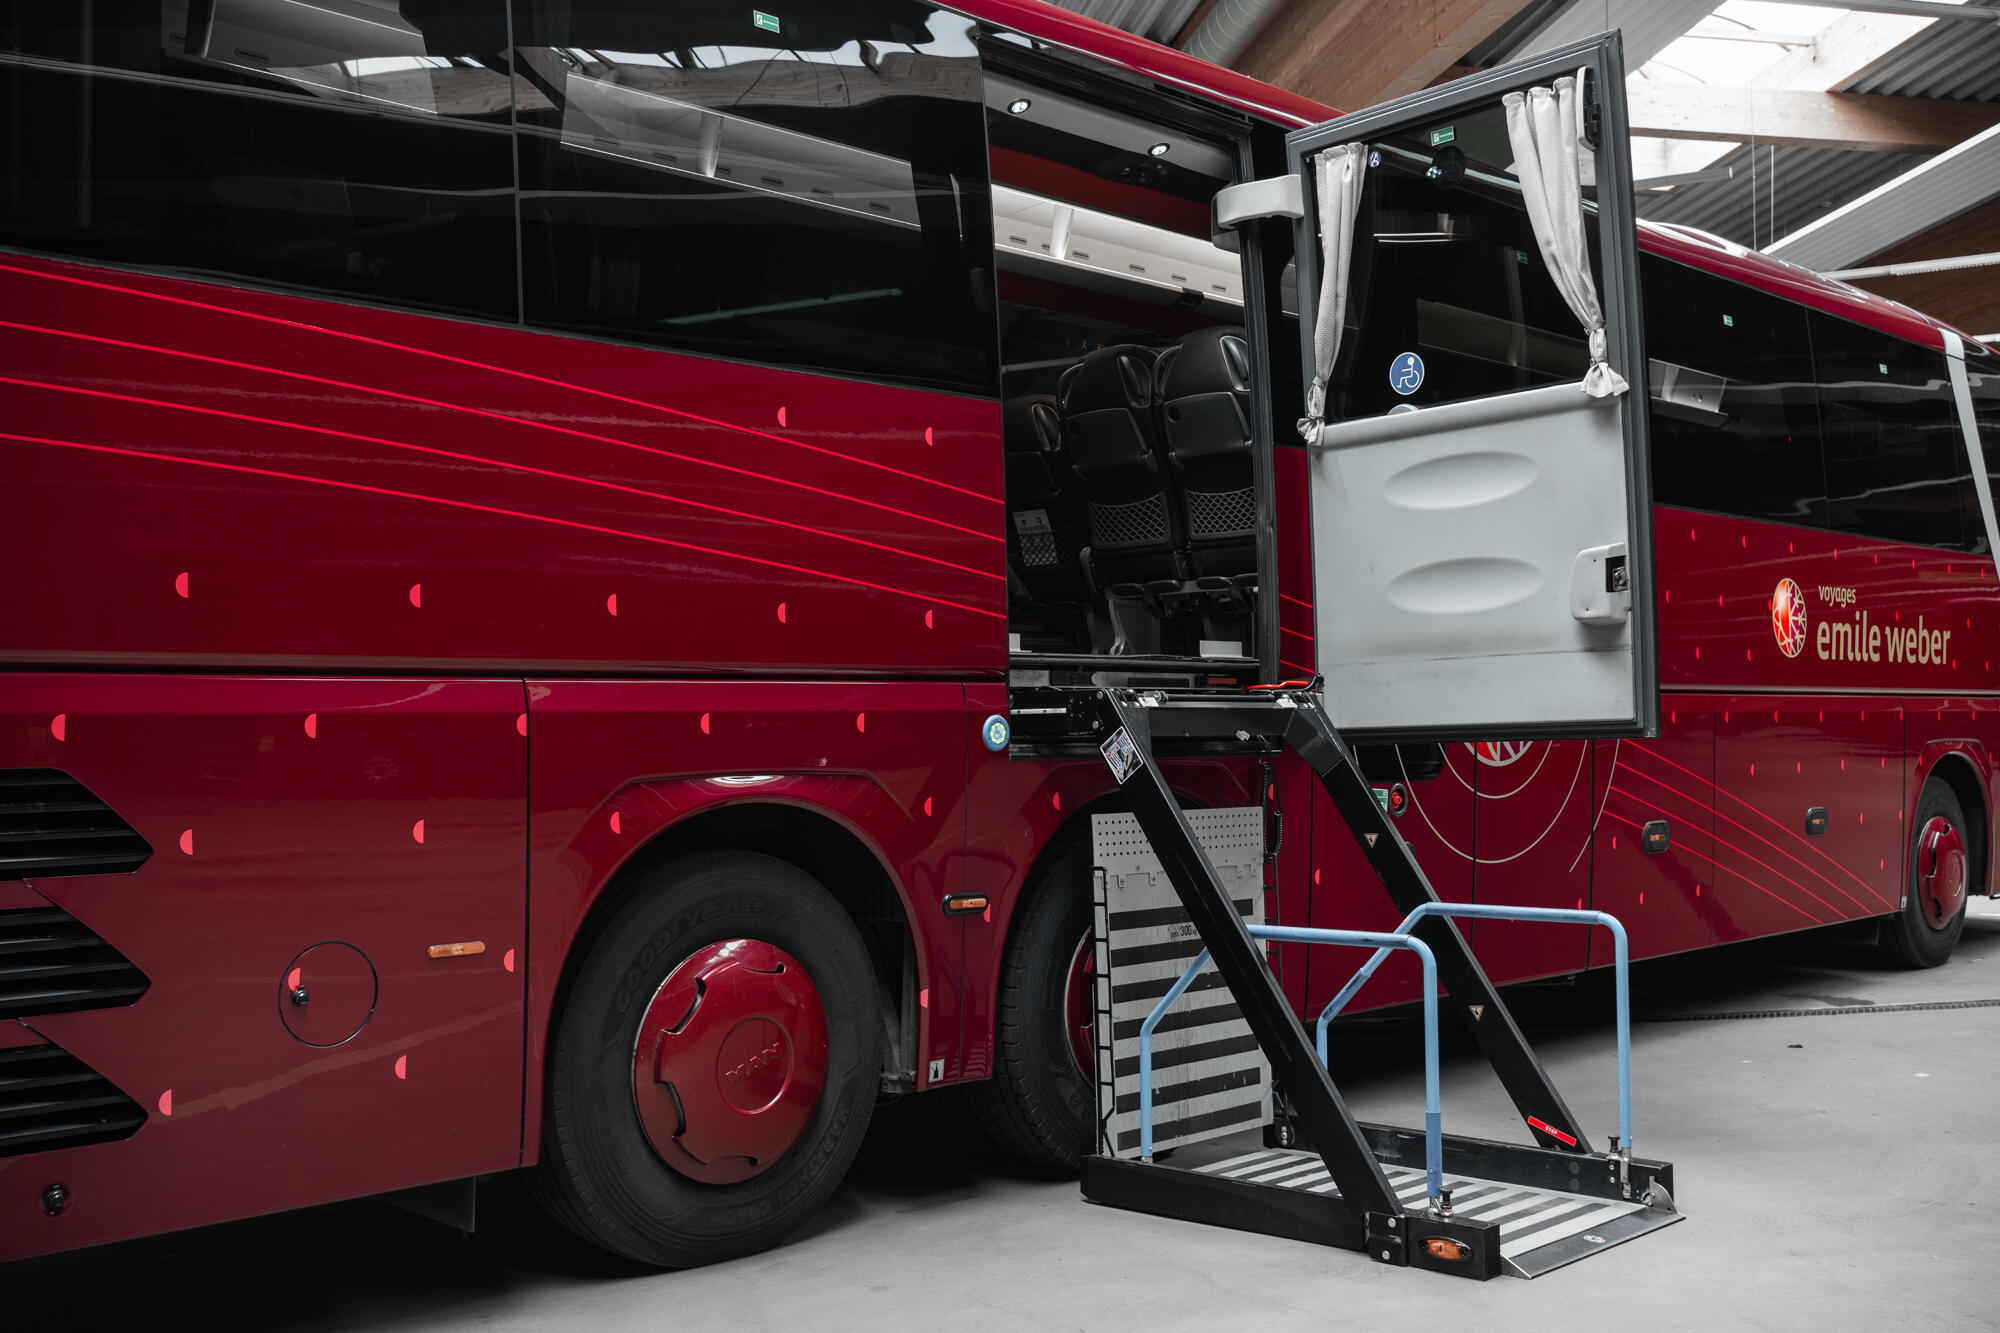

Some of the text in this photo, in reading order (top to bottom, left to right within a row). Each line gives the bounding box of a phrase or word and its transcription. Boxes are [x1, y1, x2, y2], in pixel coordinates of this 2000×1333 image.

[1818, 584, 1856, 608] voyages
[1816, 610, 1951, 665] emile weber
[1180, 924, 1192, 937] 300
[725, 1042, 782, 1087] MAN
[1545, 1126, 1558, 1135] STOP
